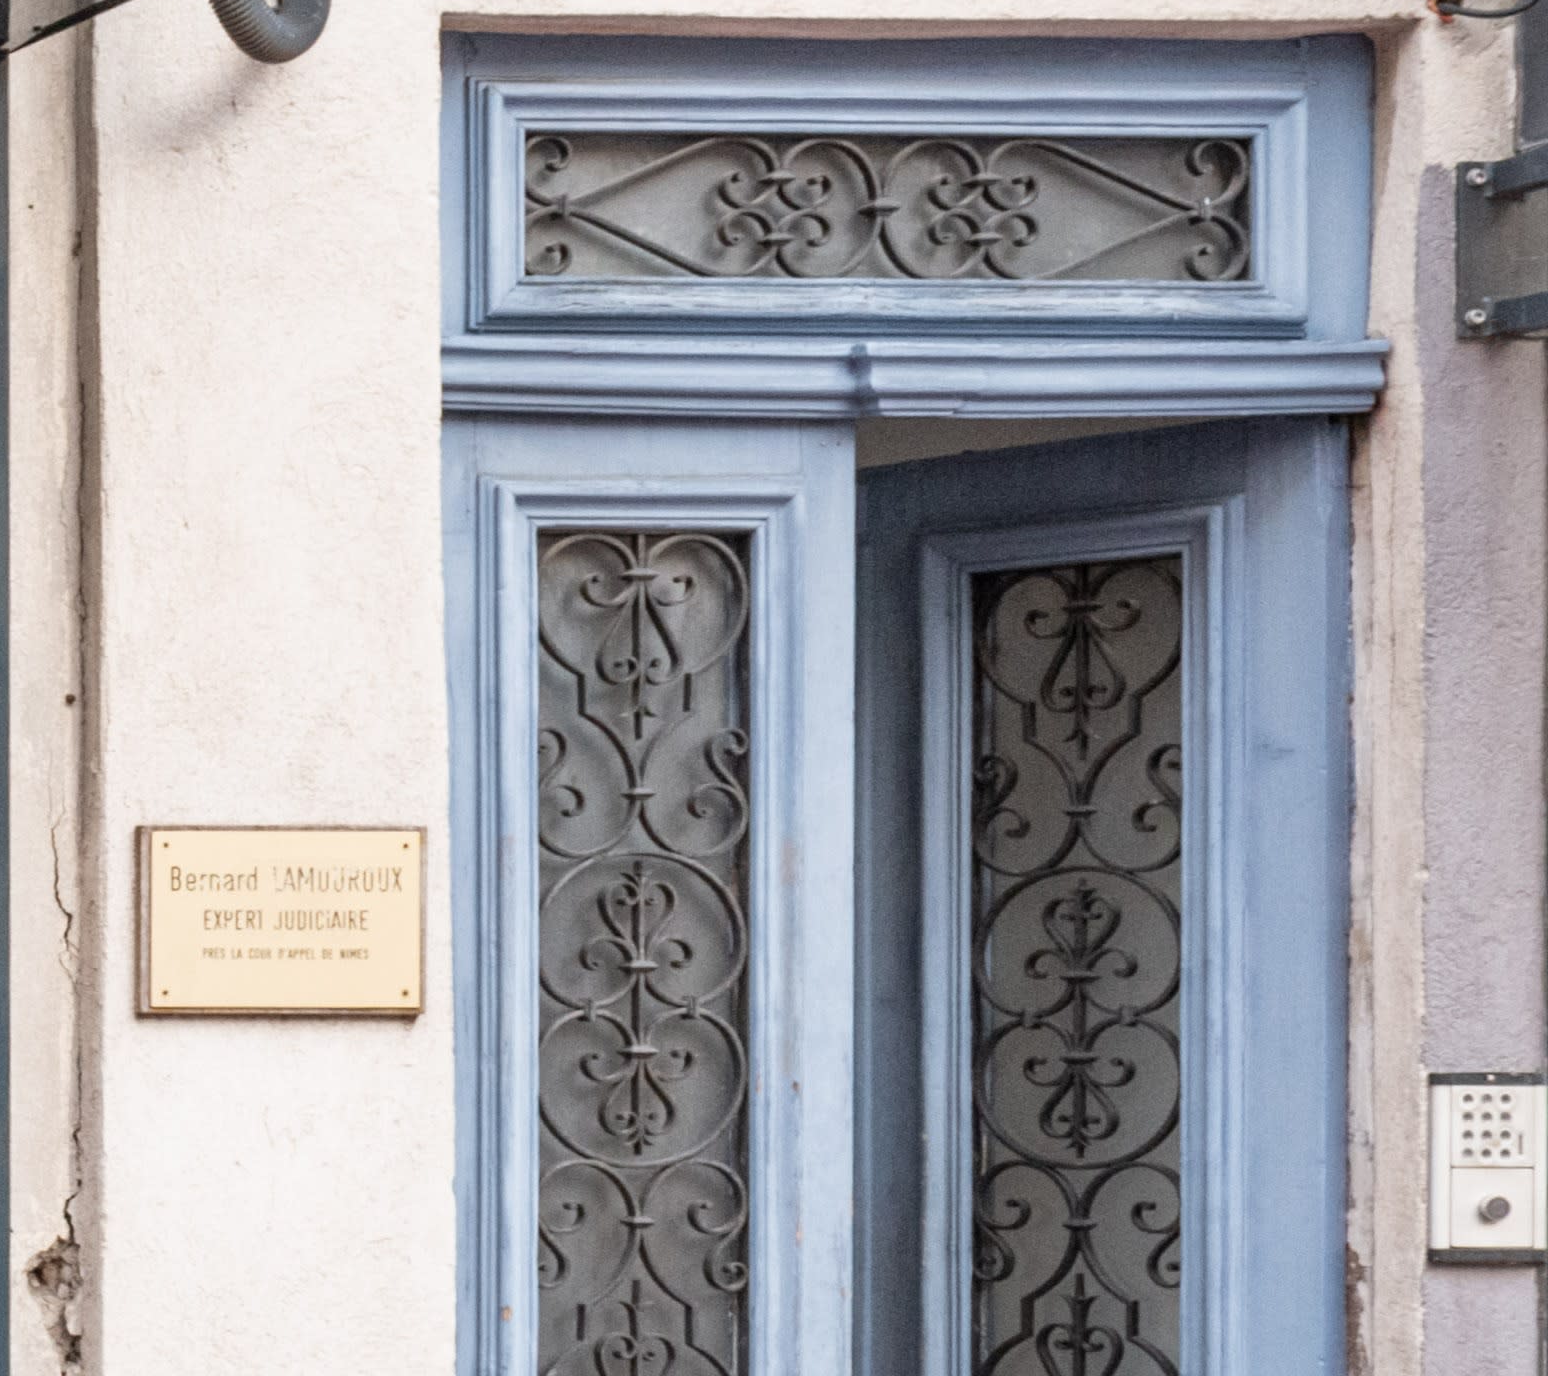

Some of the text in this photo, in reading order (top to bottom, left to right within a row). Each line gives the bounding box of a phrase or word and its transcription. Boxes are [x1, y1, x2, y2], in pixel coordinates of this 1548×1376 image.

[171, 866, 257, 892] Bernard
[204, 910, 369, 930] EXPERT JUDICIAIRE
